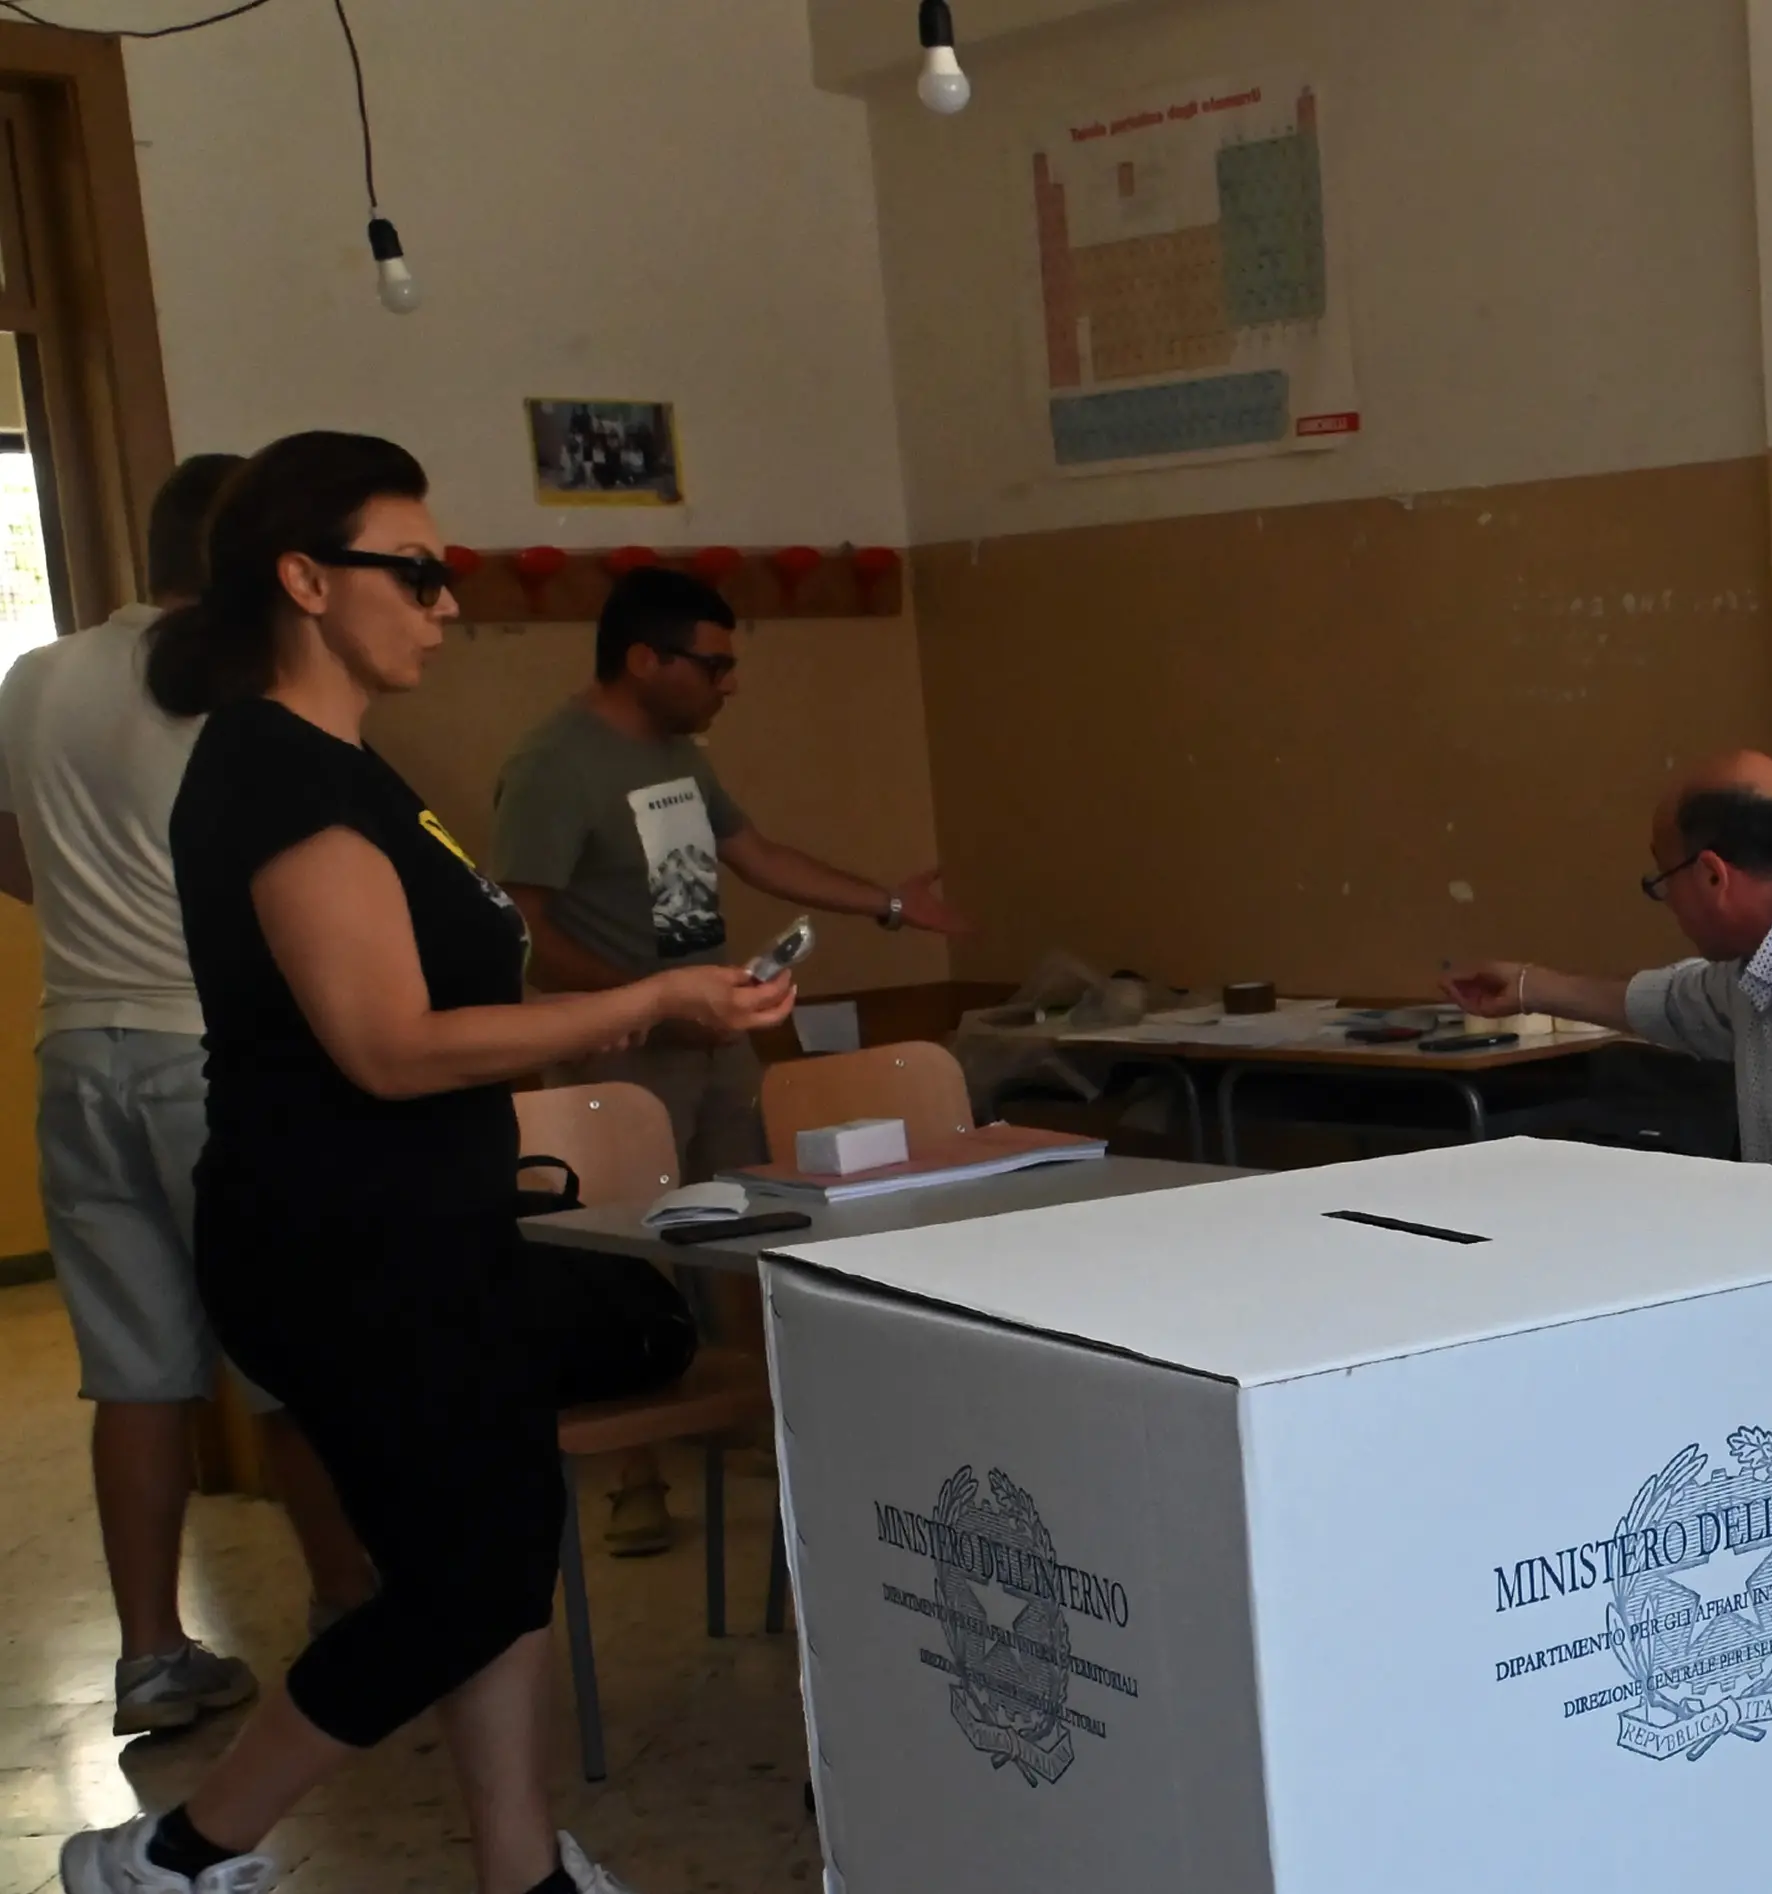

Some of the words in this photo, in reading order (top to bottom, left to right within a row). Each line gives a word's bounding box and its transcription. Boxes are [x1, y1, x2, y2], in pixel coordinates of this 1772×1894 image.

[874, 1500, 973, 1572] MINISTERO
[977, 1534, 1129, 1627] DELL'INTERNO
[1494, 1520, 1688, 1613] MINISTERO
[1070, 1655, 1138, 1698] TERRITORIALI
[1495, 1628, 1626, 1682] DIPARTIMENTO
[1629, 1620, 1660, 1642] PER
[1663, 1609, 1692, 1631] GLI
[1695, 1595, 1749, 1623] AFFARI
[1563, 1679, 1643, 1718] DIREZIONE
[1646, 1660, 1717, 1691] CENTRALE
[1719, 1650, 1745, 1671] PER
[1623, 1712, 1722, 1752] REPVBBLICA
